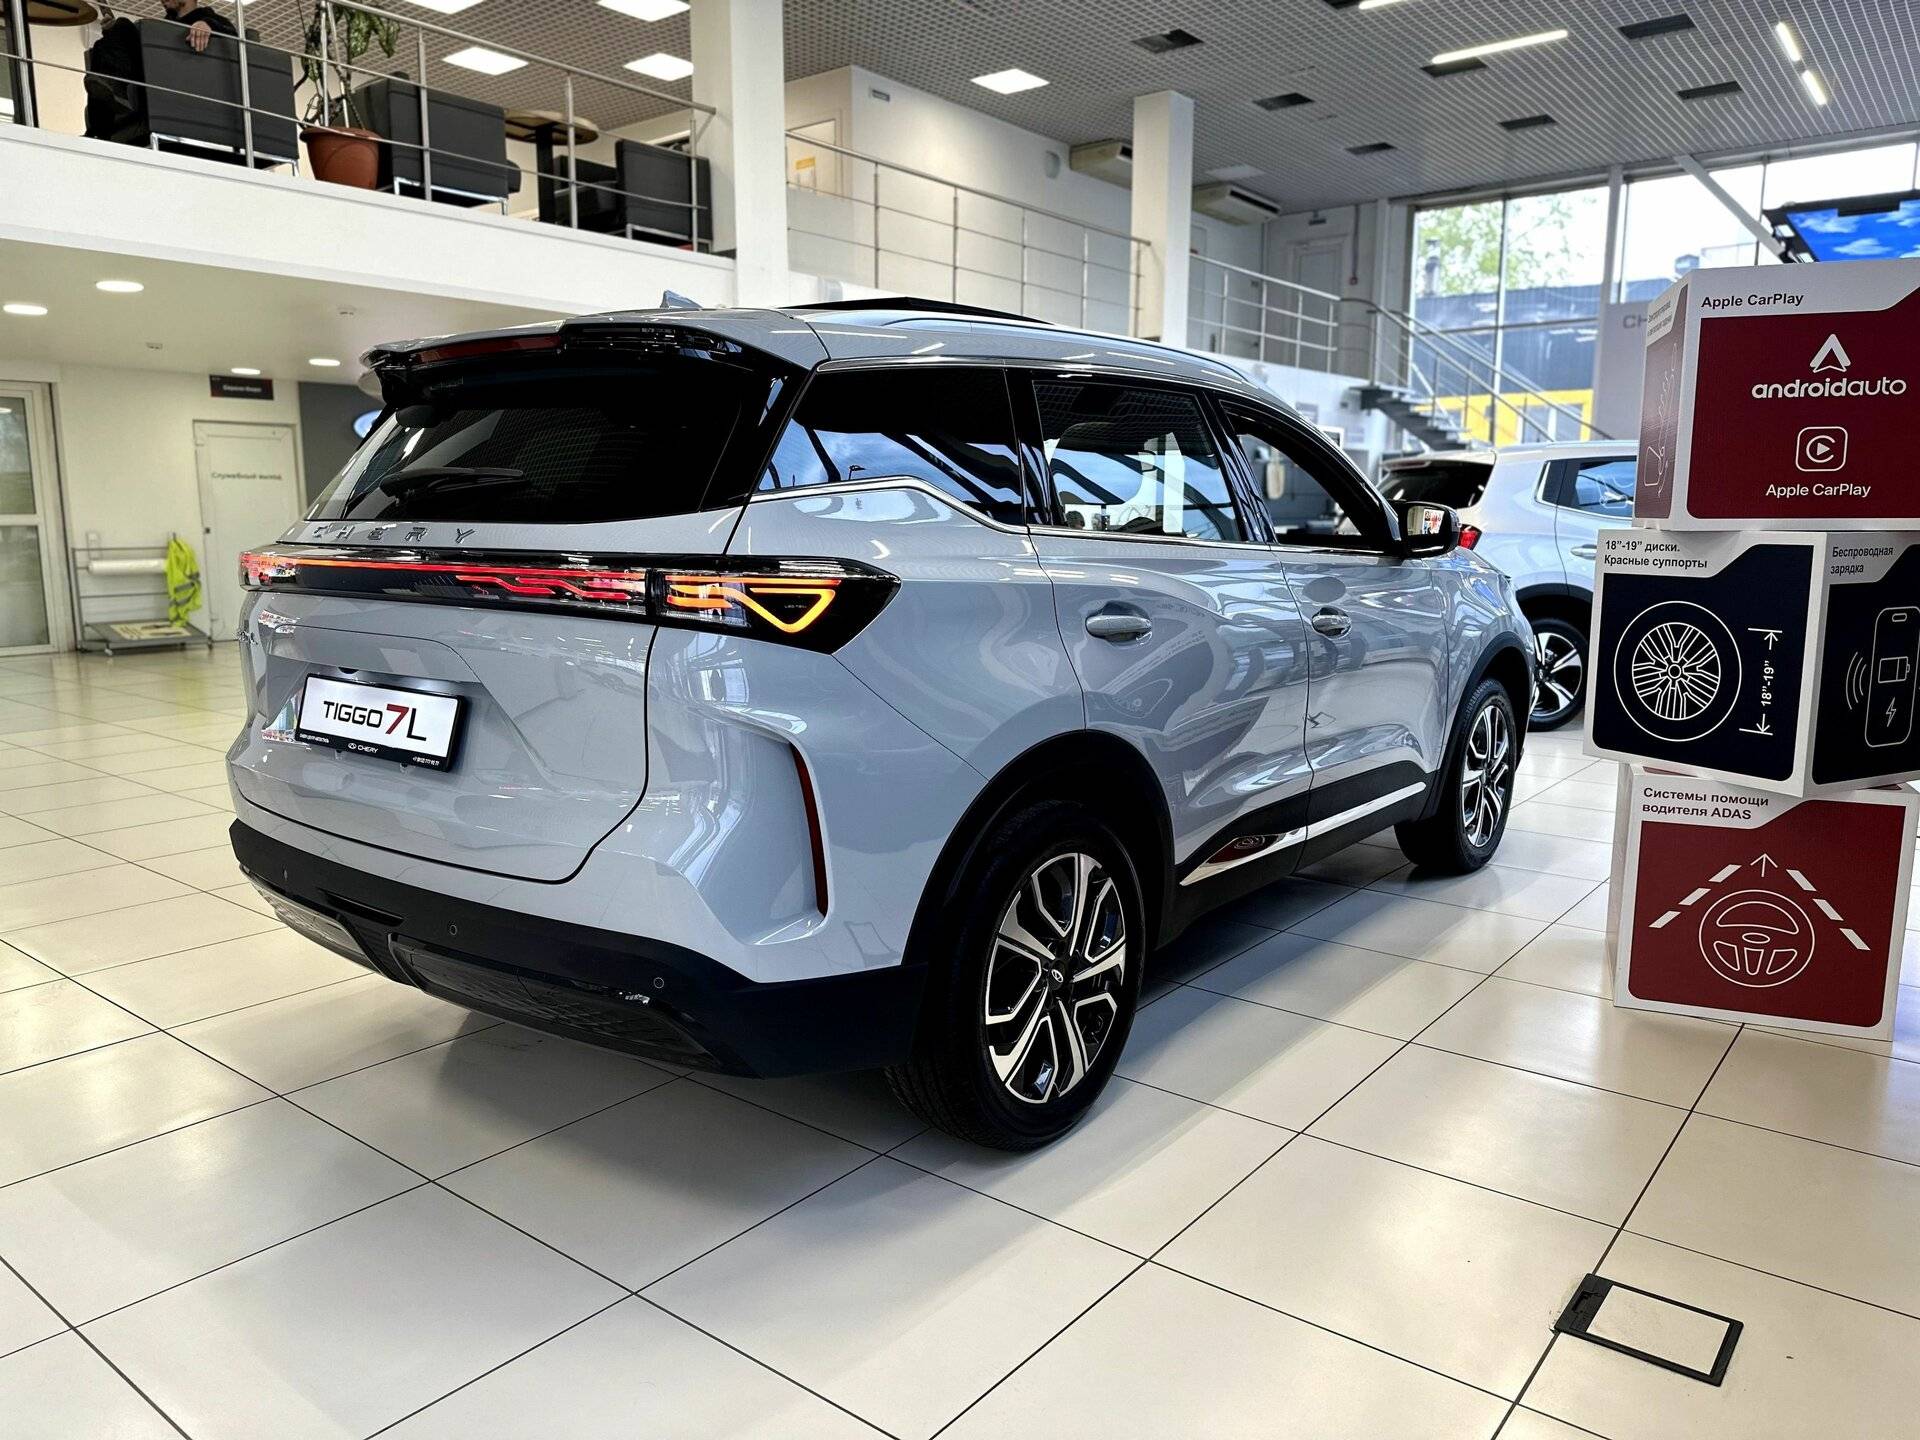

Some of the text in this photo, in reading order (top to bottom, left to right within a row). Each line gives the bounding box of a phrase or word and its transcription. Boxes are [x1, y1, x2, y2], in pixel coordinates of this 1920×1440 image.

[1701, 293, 1804, 309] Apple CarPlay
[1751, 376, 1907, 399] androidauto
[1765, 483, 1871, 498] Apple CarPlay
[312, 523, 477, 544] CHERY
[1644, 543, 1680, 553] диски.
[1832, 546, 1894, 559] Беспроводная
[1604, 554, 1708, 570] Красные суппорты
[1830, 564, 1864, 576] зарядка
[1643, 787, 1769, 807] Системы помощи
[1642, 804, 1752, 820] водителя ADAS
